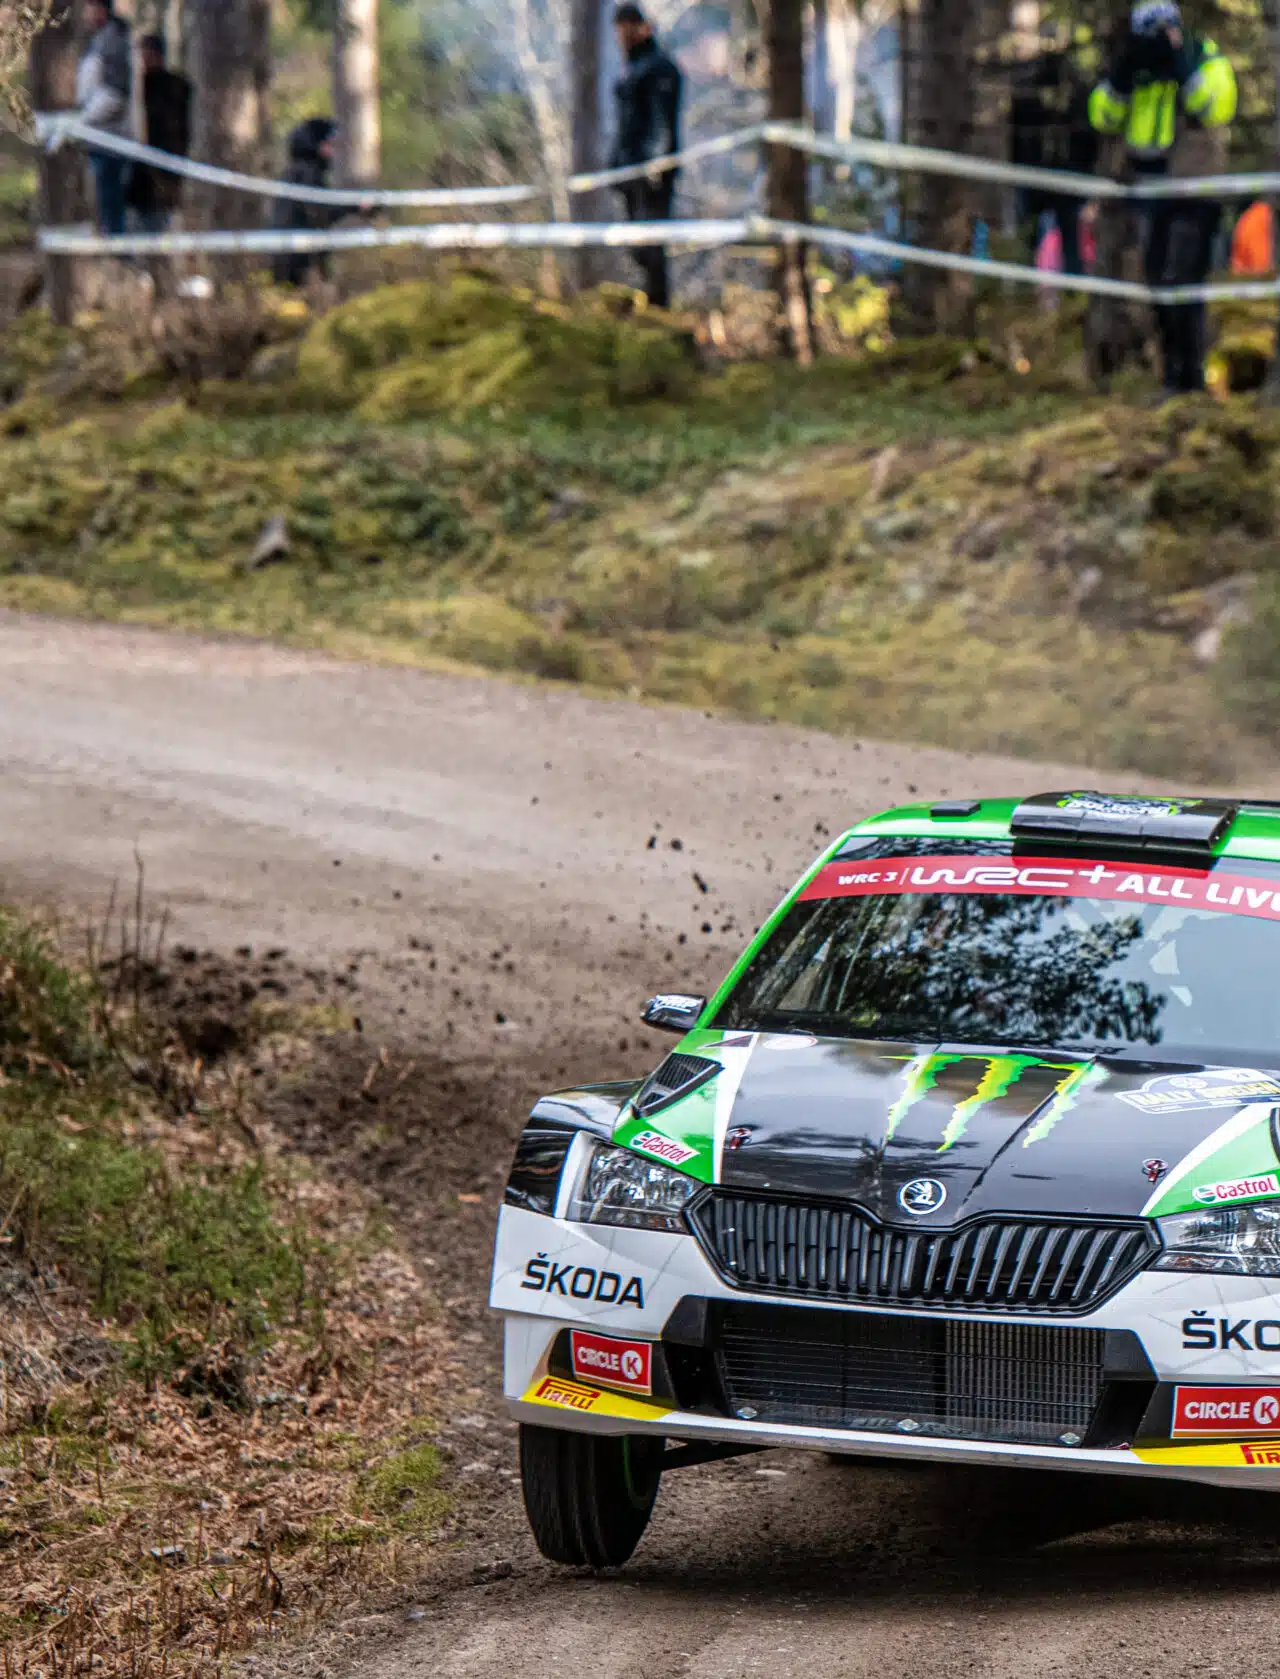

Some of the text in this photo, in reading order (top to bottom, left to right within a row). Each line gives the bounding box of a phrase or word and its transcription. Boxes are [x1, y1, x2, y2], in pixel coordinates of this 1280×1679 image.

[838, 872, 878, 885] WRC
[884, 871, 897, 882] 3
[1116, 874, 1193, 899] ALL
[641, 1136, 692, 1162] Castrol
[1216, 1177, 1277, 1199] Castrol
[521, 1252, 645, 1309] ŠKODA
[577, 1346, 641, 1378] CIRCLE K
[535, 1378, 602, 1410] PIRELLI
[1184, 1399, 1278, 1421] CIRCLE K
